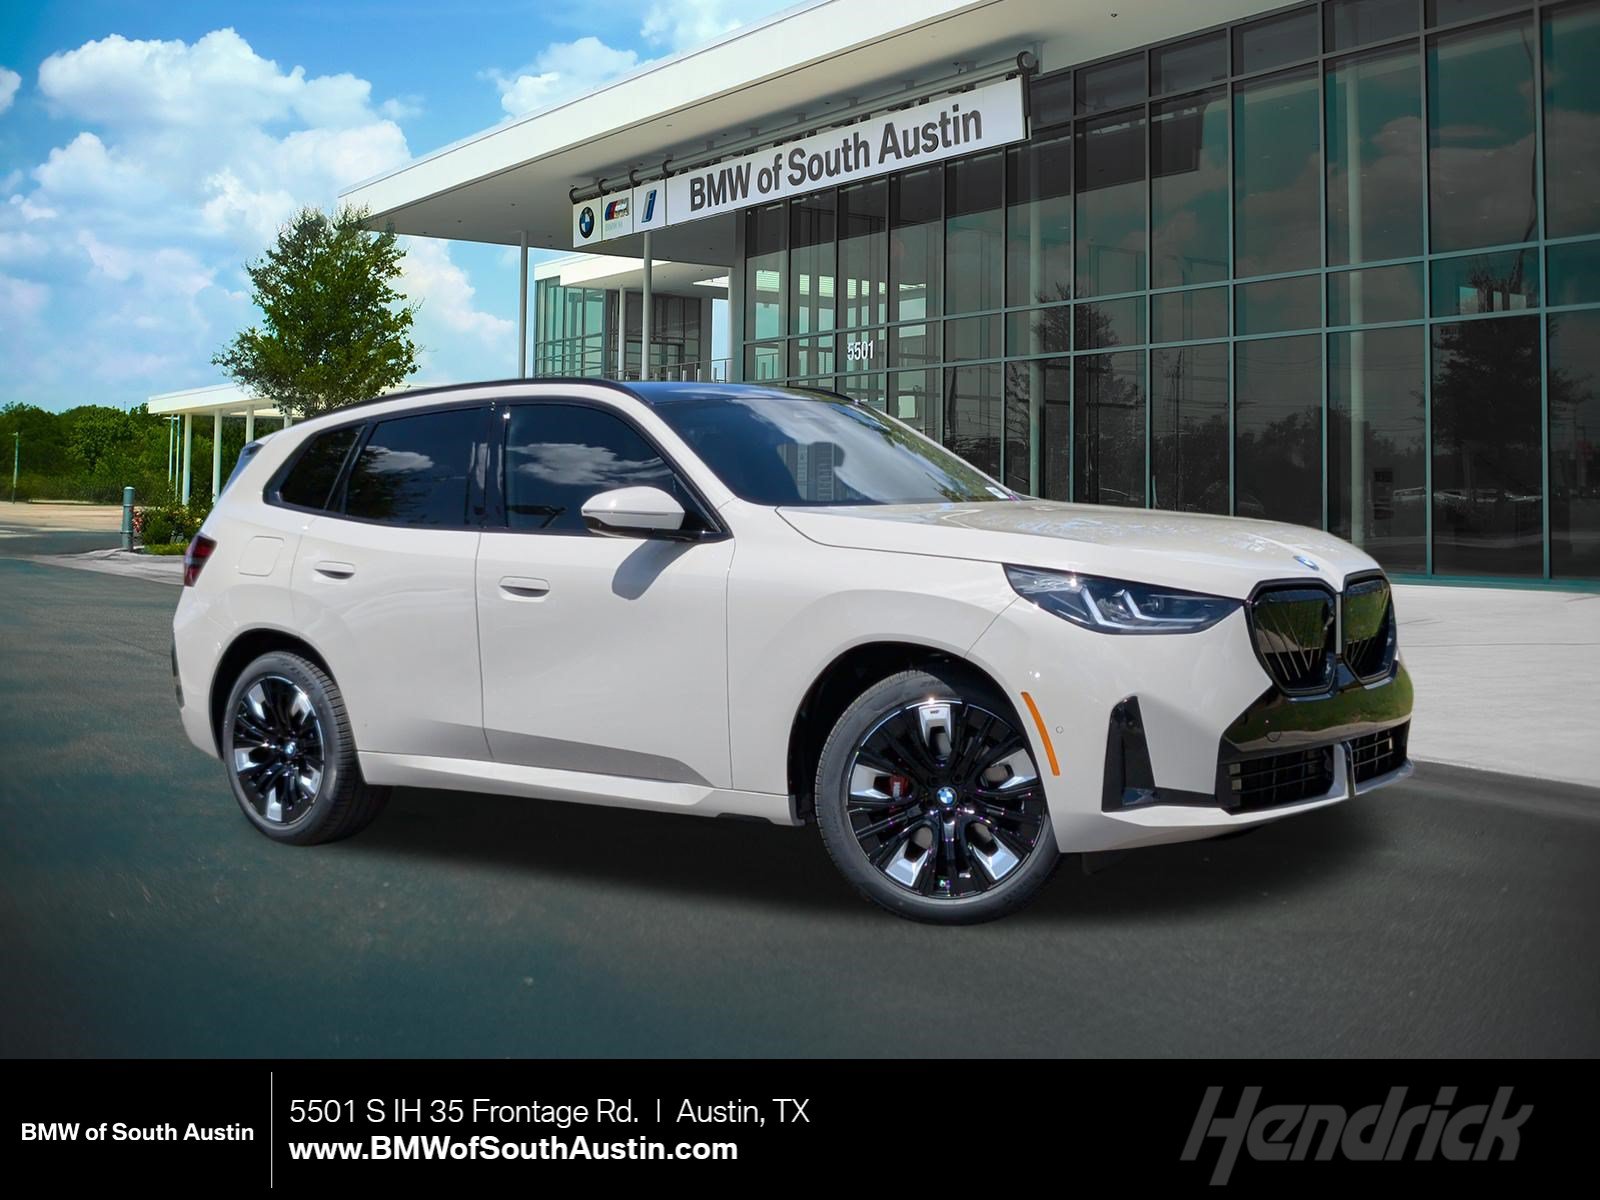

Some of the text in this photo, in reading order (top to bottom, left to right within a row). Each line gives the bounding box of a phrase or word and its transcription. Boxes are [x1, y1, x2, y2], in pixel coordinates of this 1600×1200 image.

[689, 161, 752, 212] BMW
[757, 153, 782, 194] of
[787, 131, 871, 186] South
[878, 103, 982, 165] Austin
[847, 340, 874, 361] 5501
